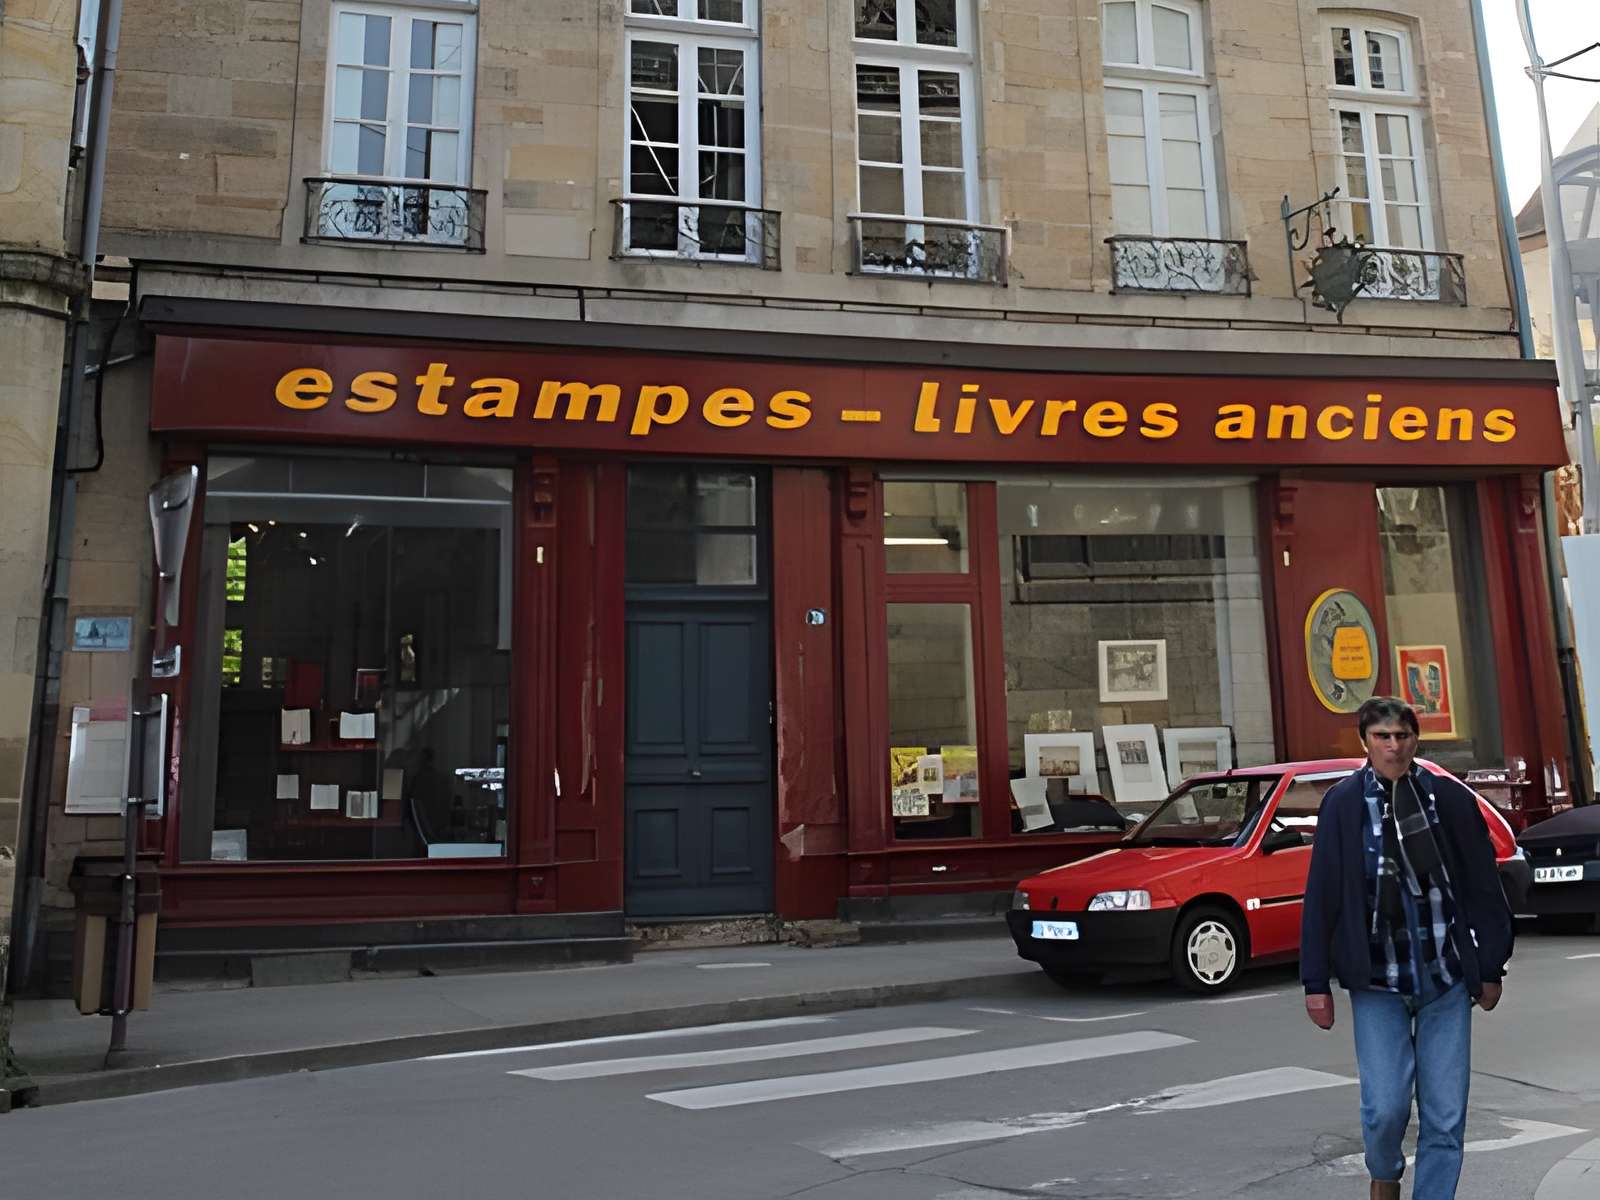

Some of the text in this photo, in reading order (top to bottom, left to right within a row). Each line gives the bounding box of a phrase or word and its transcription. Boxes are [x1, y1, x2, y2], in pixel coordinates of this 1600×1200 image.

[275, 362, 812, 436] estampes
[914, 381, 1179, 439] livres
[1214, 393, 1517, 443] anciens
